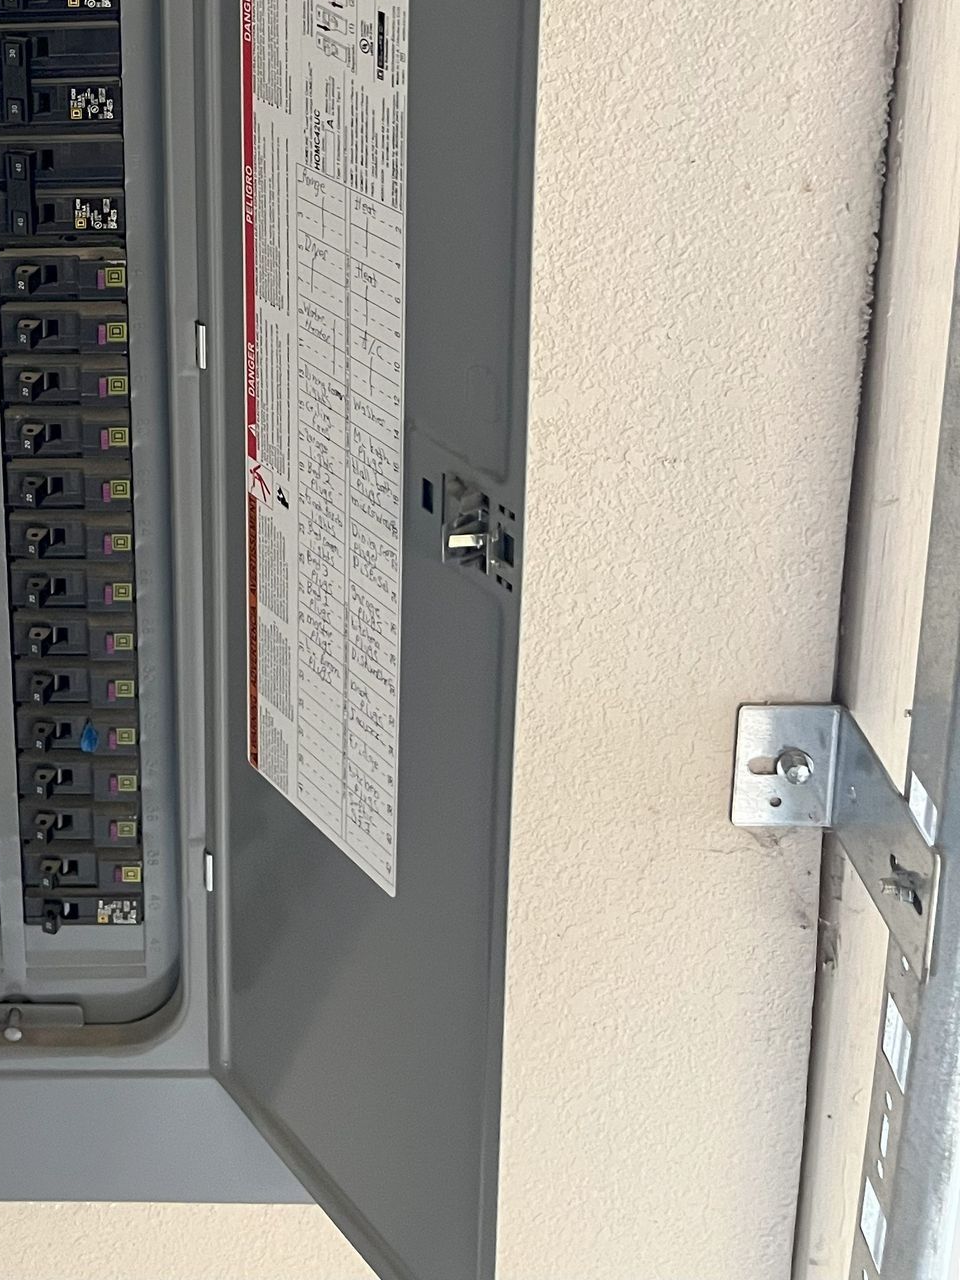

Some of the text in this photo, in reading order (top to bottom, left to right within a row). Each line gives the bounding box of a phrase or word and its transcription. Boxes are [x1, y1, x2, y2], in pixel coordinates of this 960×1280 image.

[9, 48, 16, 58] 30
[11, 104, 19, 114] 30
[327, 117, 333, 129] A
[15, 163, 22, 172] 40
[245, 165, 253, 224] PELIGRO
[354, 196, 375, 218] Heat
[17, 217, 24, 227] 40
[355, 261, 377, 288] Heat
[17, 280, 25, 290] 20
[19, 334, 27, 343] 20
[247, 342, 255, 397] DANGER
[393, 360, 400, 373] 10
[22, 387, 29, 397] 20
[393, 394, 399, 407] 12
[393, 428, 399, 440] 14
[24, 440, 31, 449] 20
